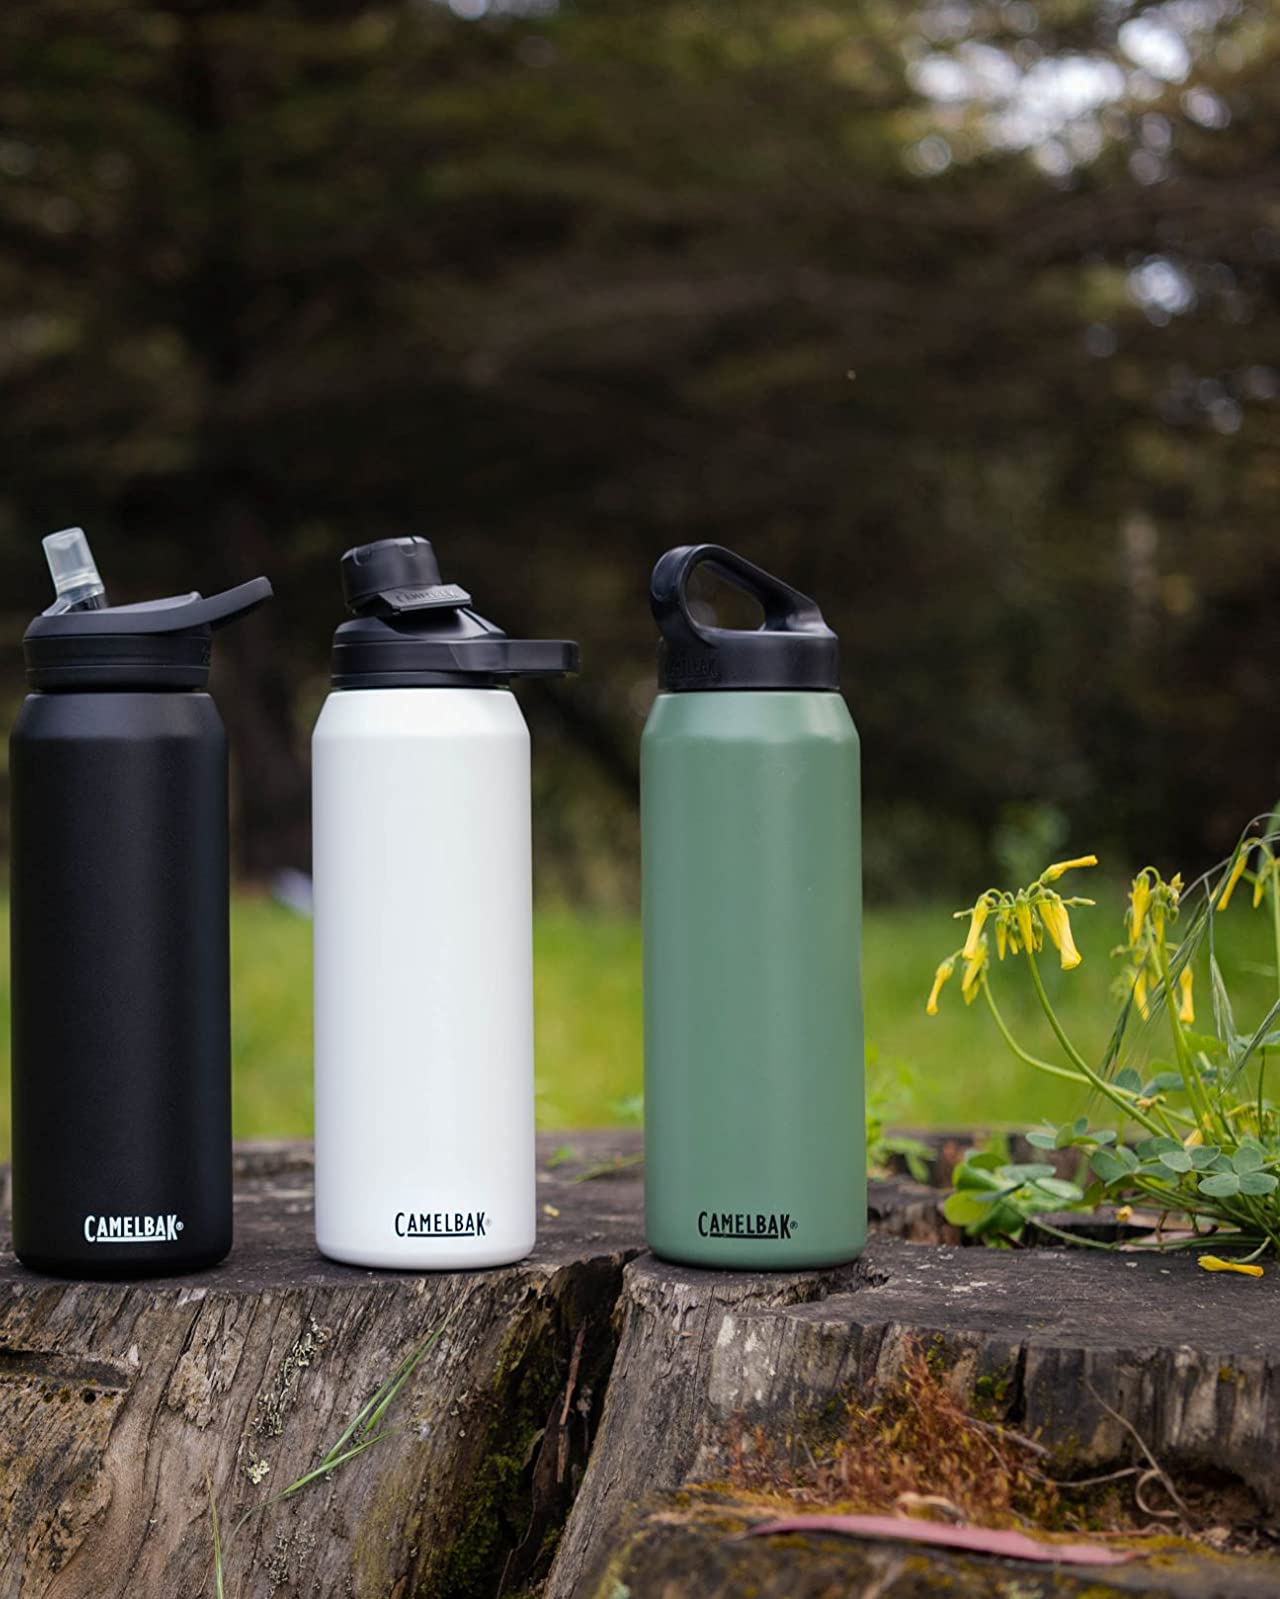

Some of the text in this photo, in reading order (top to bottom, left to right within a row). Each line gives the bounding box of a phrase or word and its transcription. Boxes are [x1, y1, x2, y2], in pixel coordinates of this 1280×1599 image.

[84, 1214, 178, 1242] CAMELBAK
[395, 1211, 486, 1238] CAMELBAK
[698, 1211, 791, 1239] CAMELBAK
